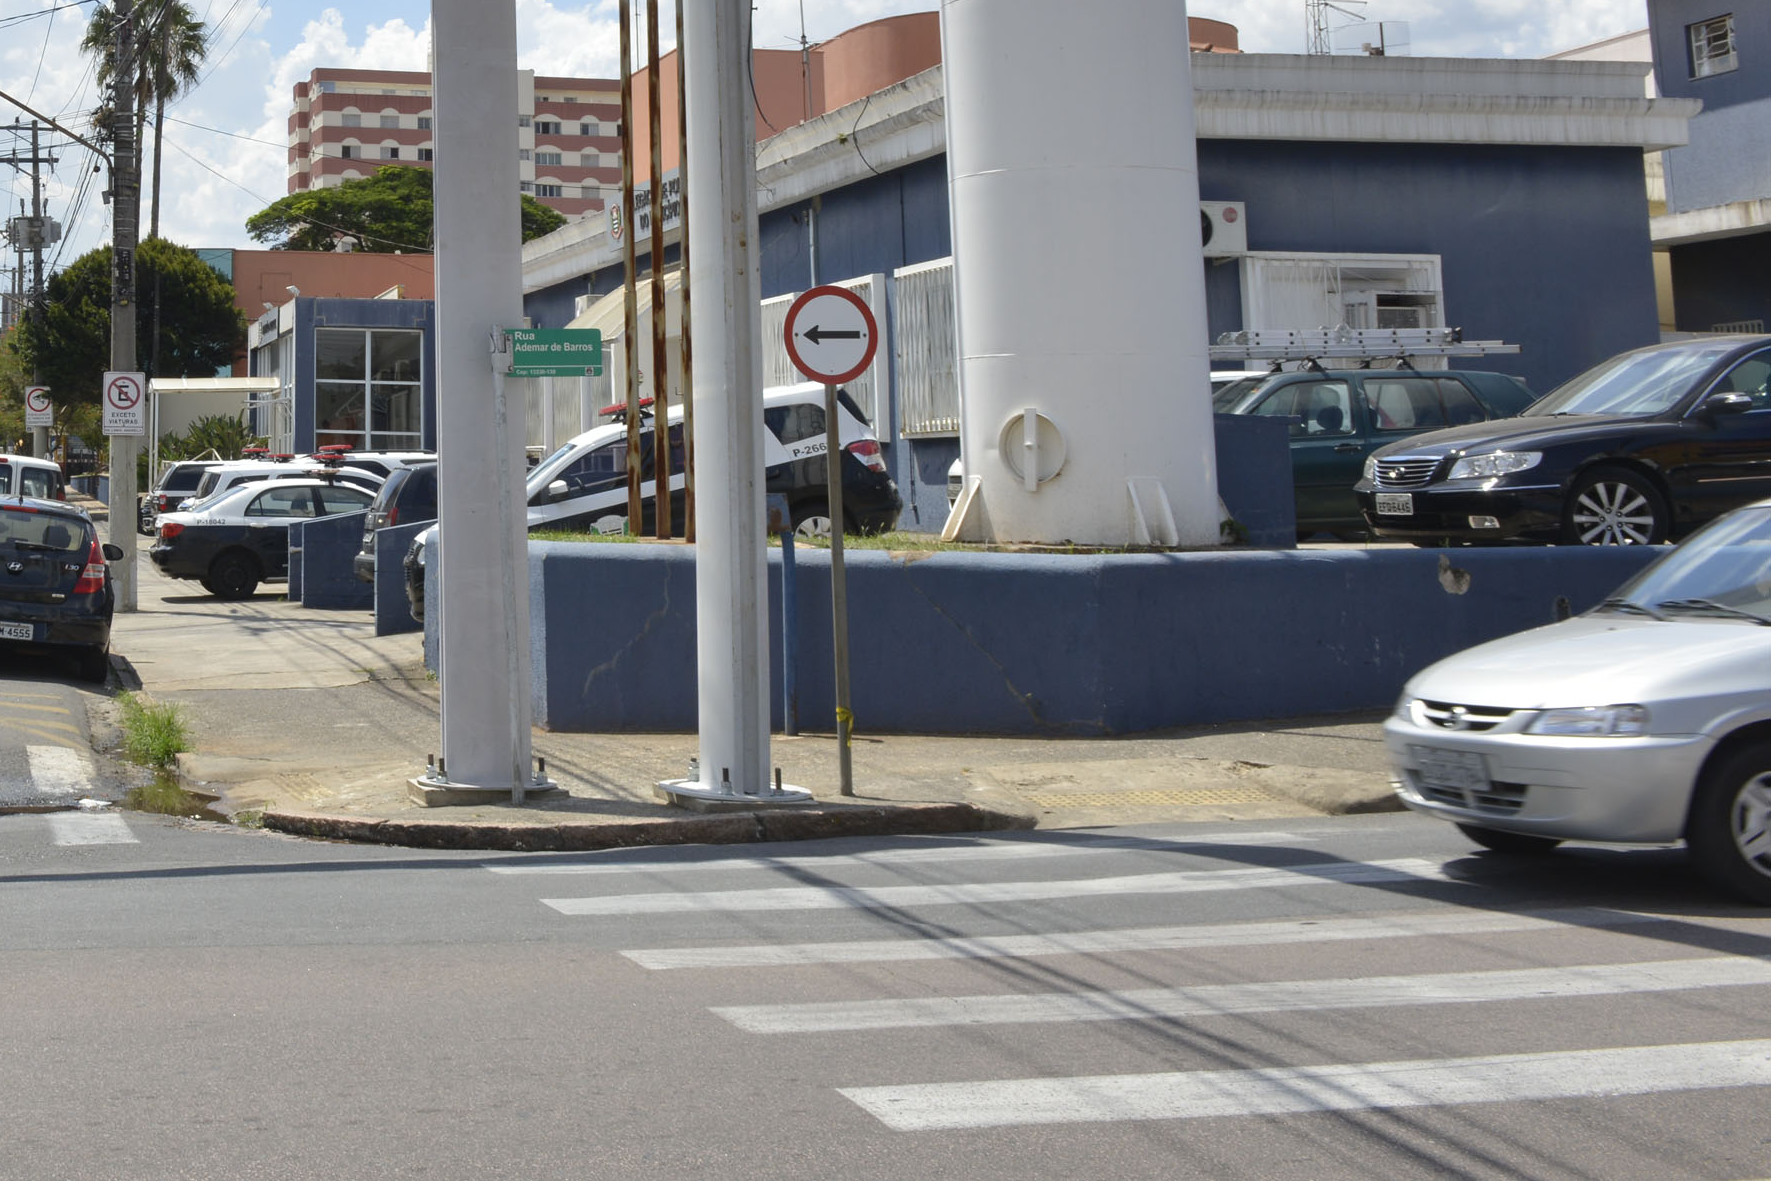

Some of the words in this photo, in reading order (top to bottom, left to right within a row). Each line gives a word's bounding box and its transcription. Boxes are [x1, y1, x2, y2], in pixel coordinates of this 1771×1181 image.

[514, 331, 535, 340] Rua
[514, 343, 548, 352] Ademar
[550, 343, 562, 351] de
[563, 342, 593, 351] Barros
